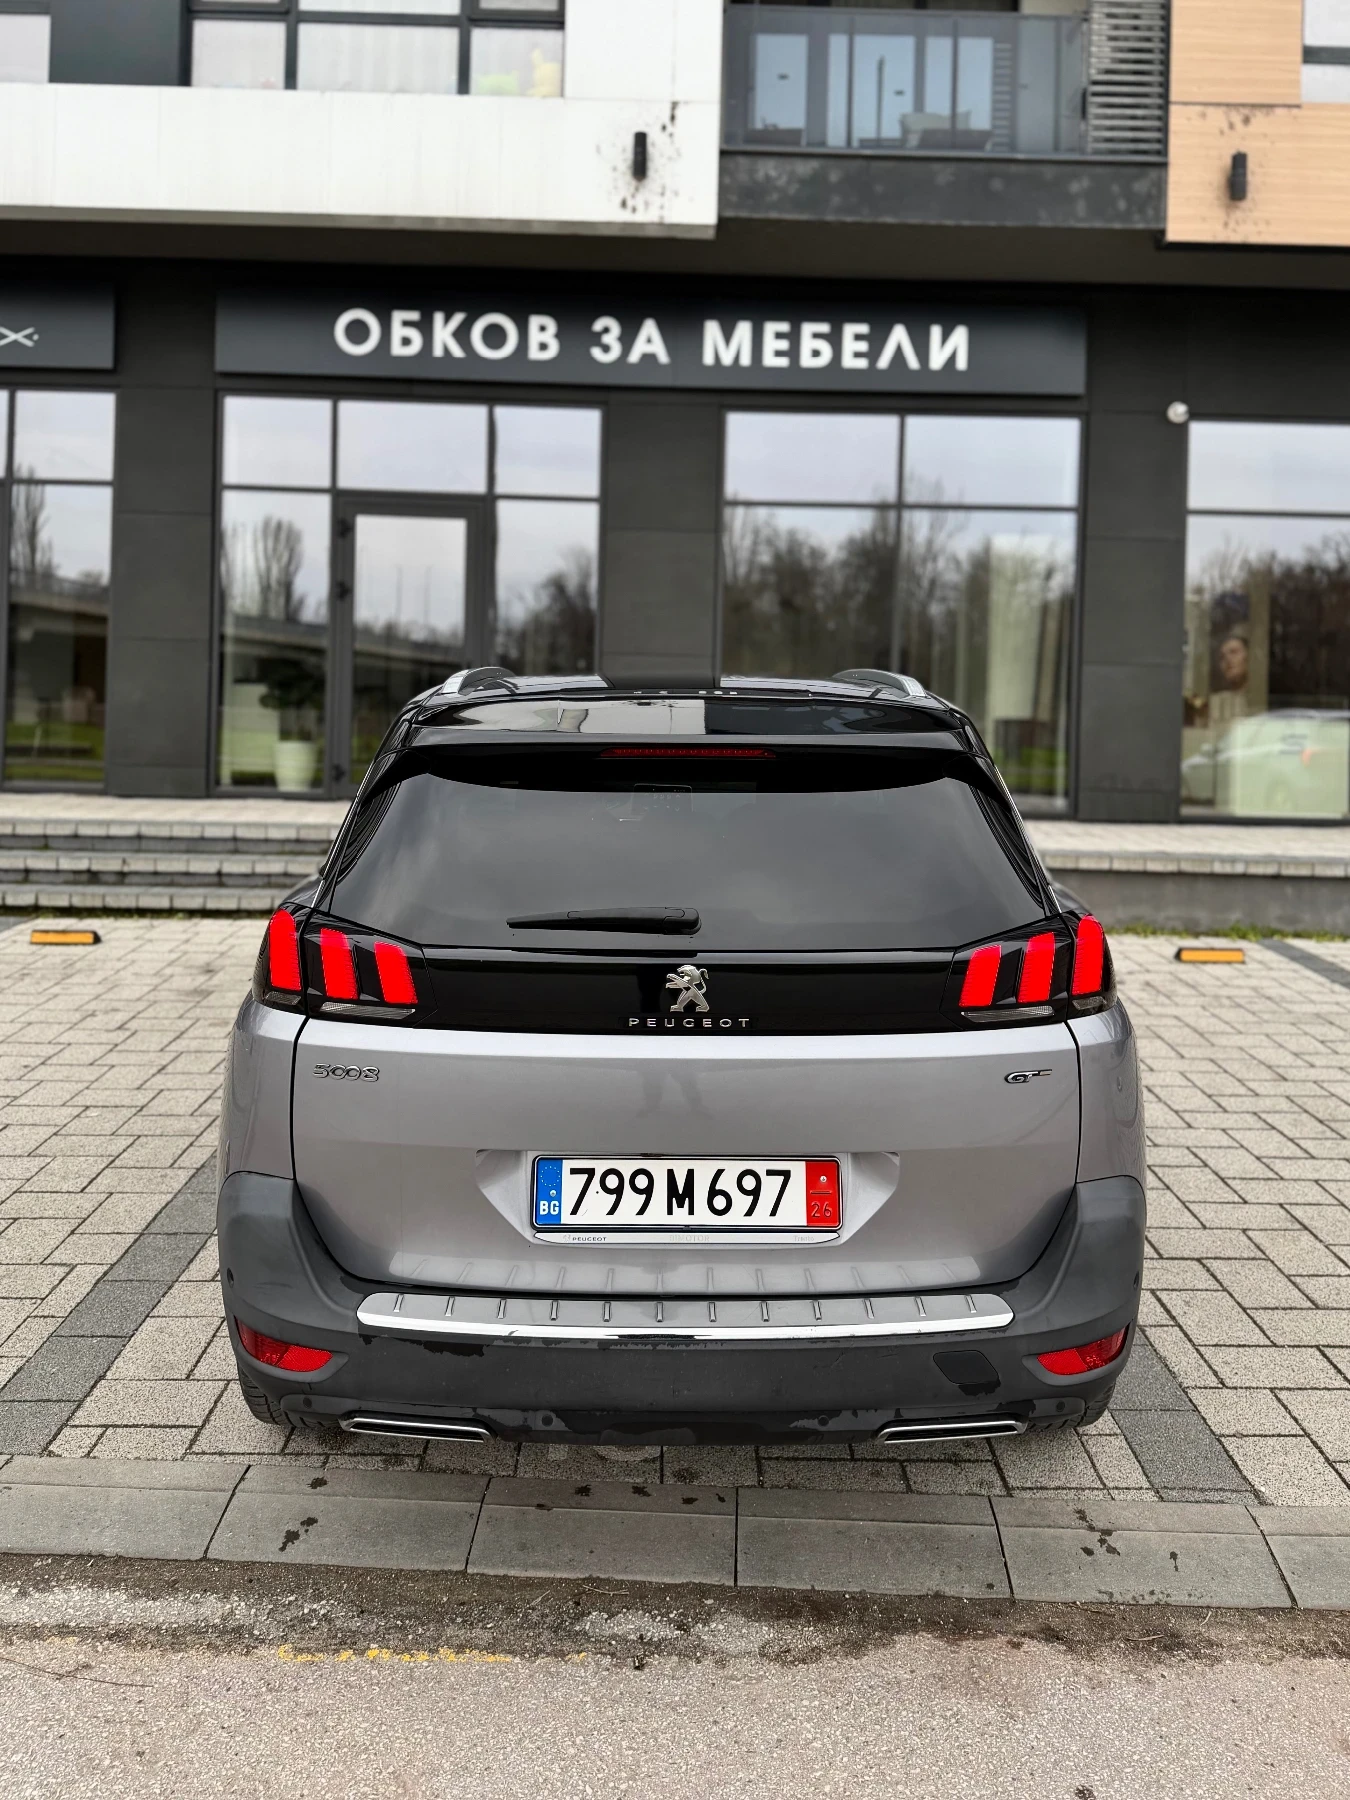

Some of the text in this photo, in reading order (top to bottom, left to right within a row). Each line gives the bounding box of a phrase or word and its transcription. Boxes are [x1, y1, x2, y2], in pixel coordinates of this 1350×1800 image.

[334, 308, 969, 371] ОБКОВ ЗА МЕБЕЛИ
[628, 1018, 750, 1028] PEUGEOT
[312, 1063, 380, 1082] 5008
[1004, 1069, 1052, 1084] GT
[569, 1167, 792, 1217] 799 M 697
[539, 1200, 560, 1216] BG
[810, 1202, 833, 1218] 26
